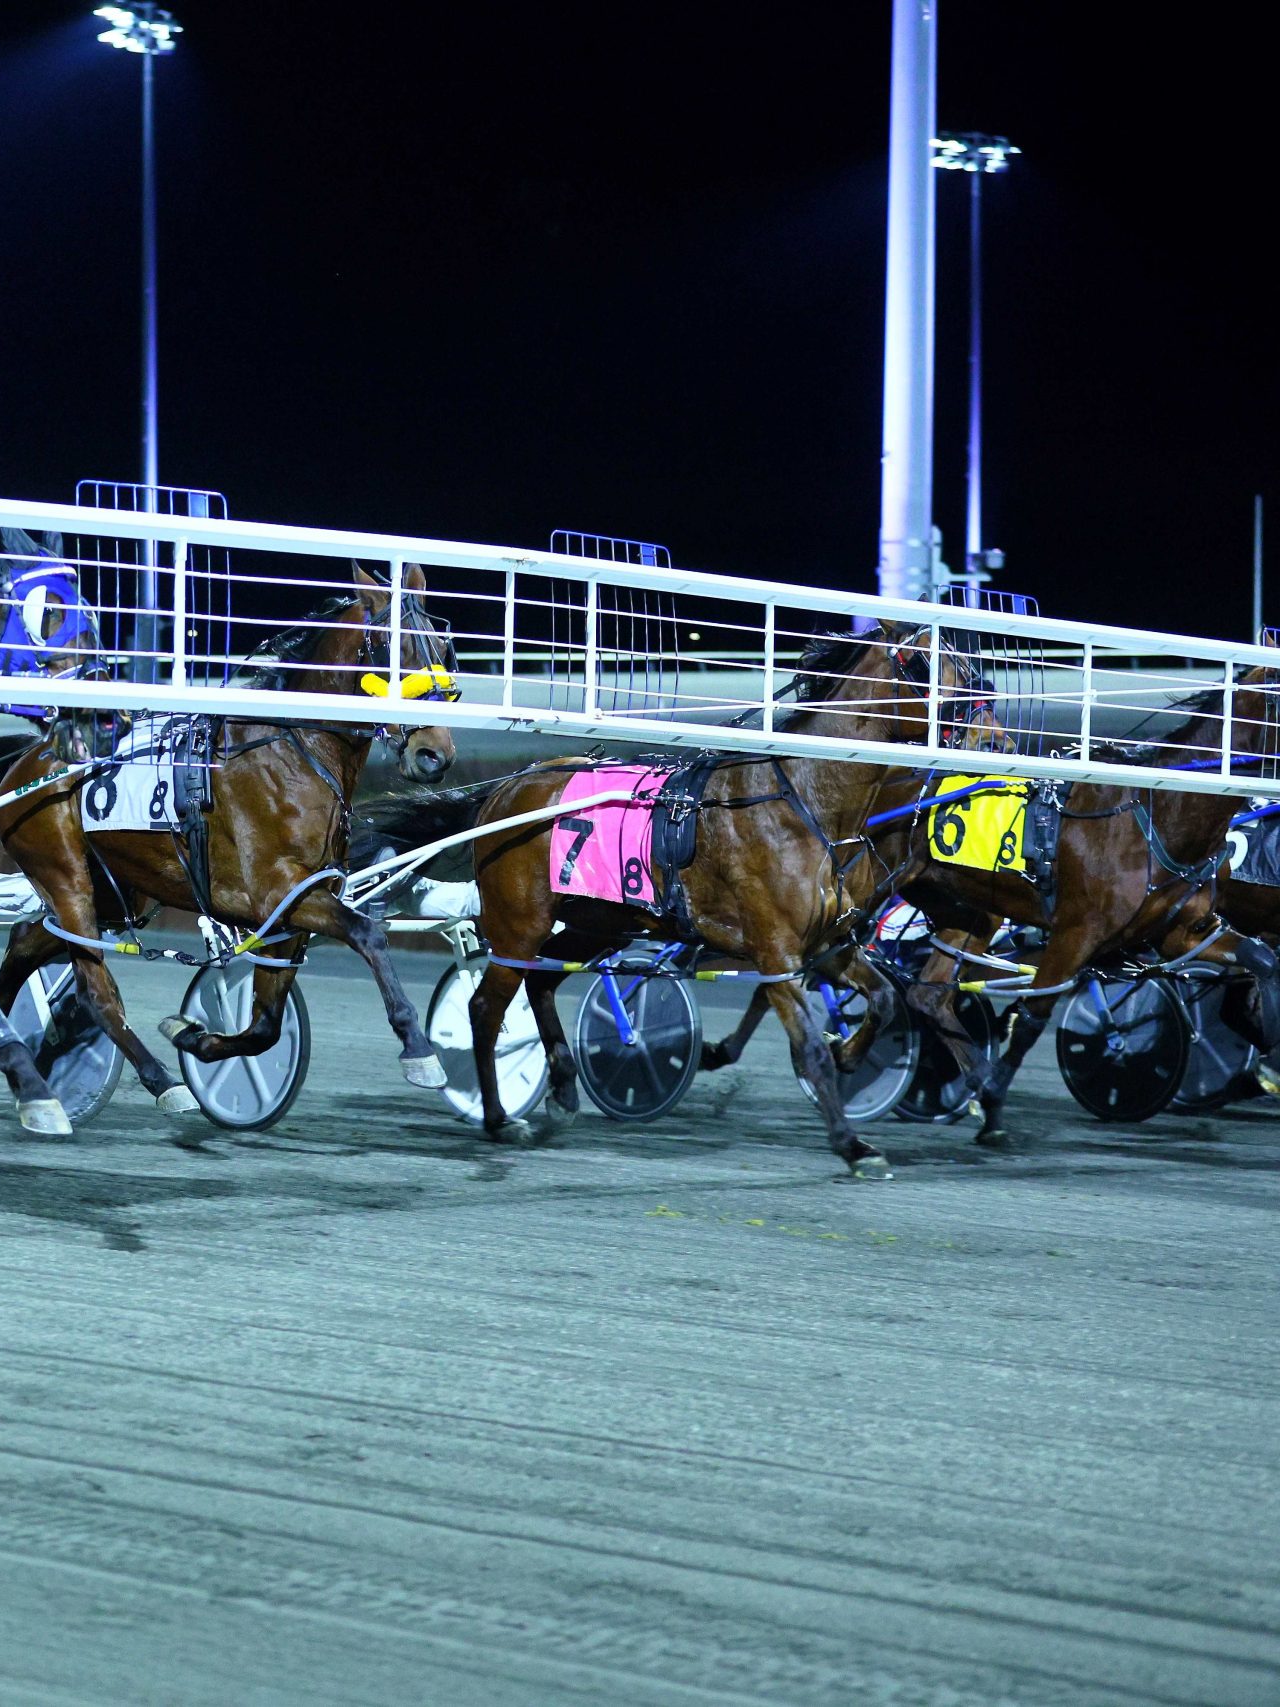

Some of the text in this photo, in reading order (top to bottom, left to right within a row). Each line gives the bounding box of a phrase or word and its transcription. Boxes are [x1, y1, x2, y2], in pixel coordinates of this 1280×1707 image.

[149, 781, 169, 819] 8
[934, 796, 972, 857] 6
[558, 816, 594, 887] 7
[998, 829, 1017, 866] 8
[623, 857, 644, 896] 8
